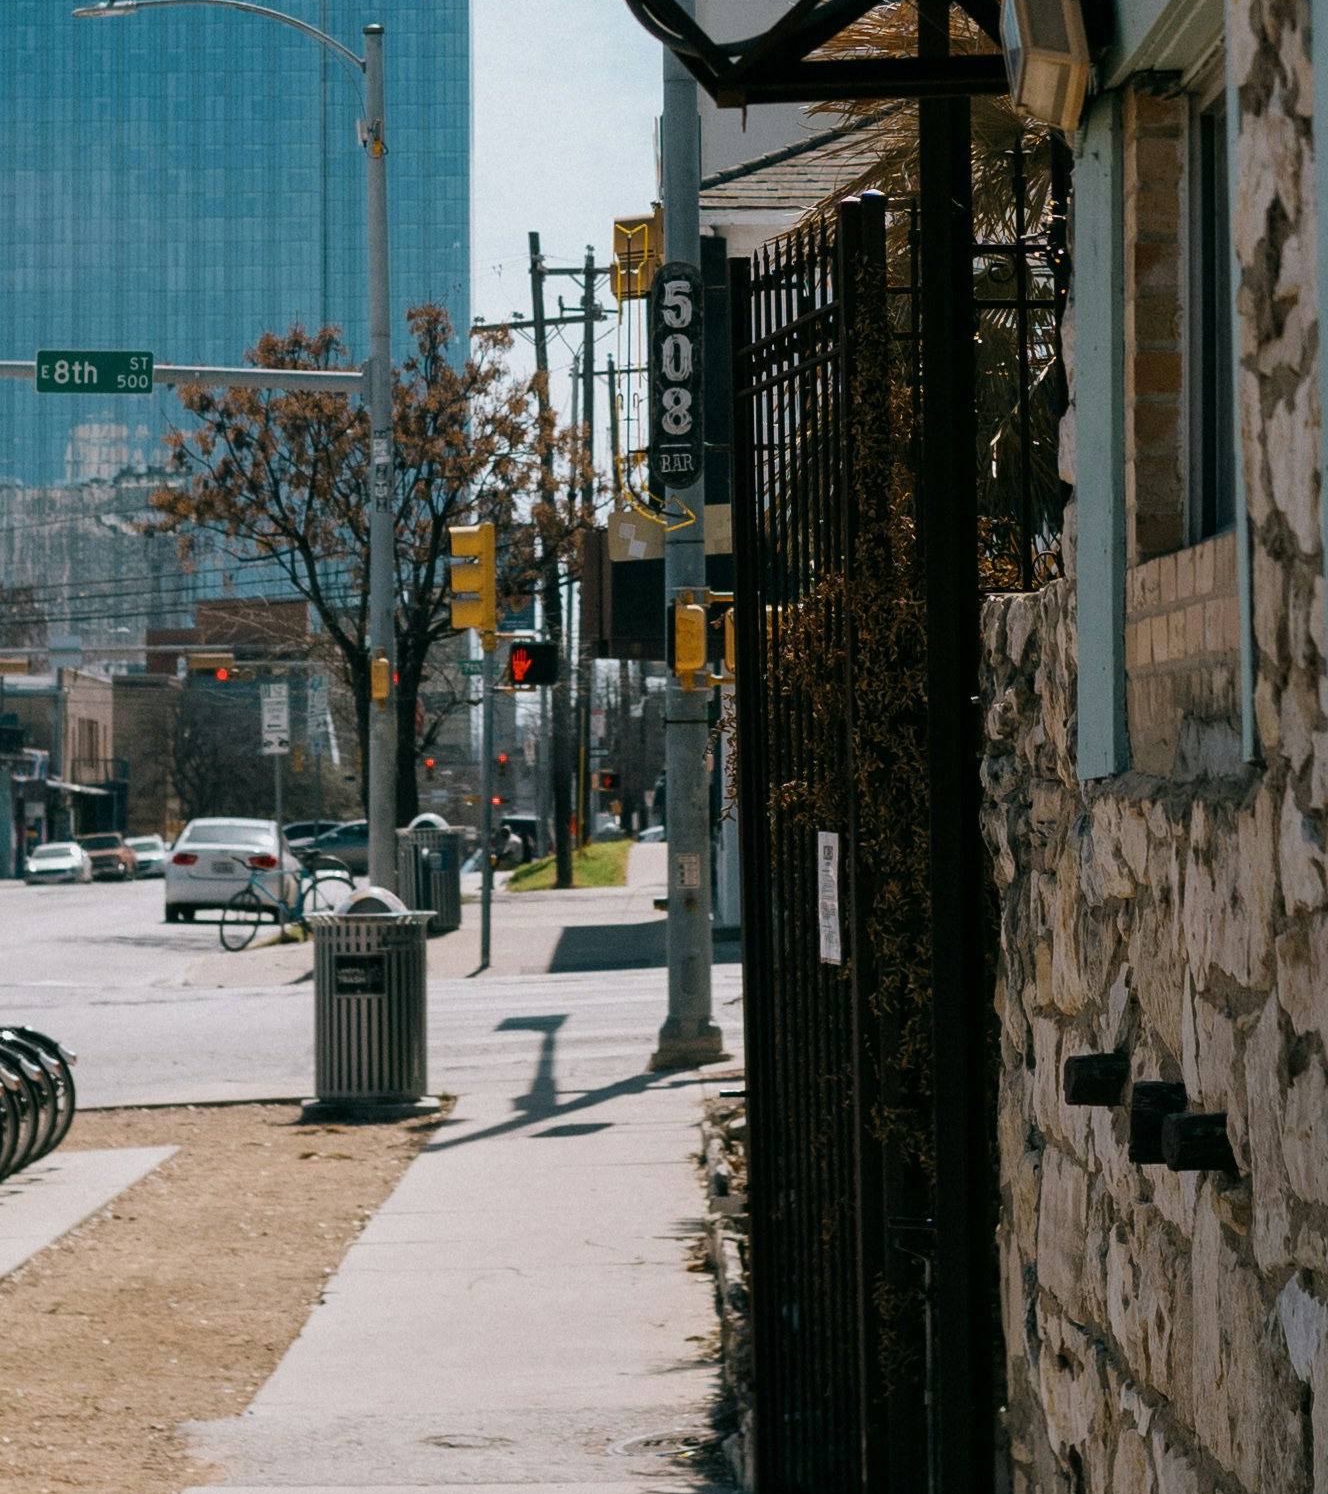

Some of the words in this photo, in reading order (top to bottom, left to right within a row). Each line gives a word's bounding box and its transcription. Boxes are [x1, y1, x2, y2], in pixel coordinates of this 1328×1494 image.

[661, 280, 693, 436] 508
[41, 365, 50, 379] E
[54, 359, 98, 384] 8th
[129, 357, 149, 371] ST
[117, 374, 149, 389] 500
[660, 453, 695, 474] BAR
[336, 975, 366, 984] TRASH
